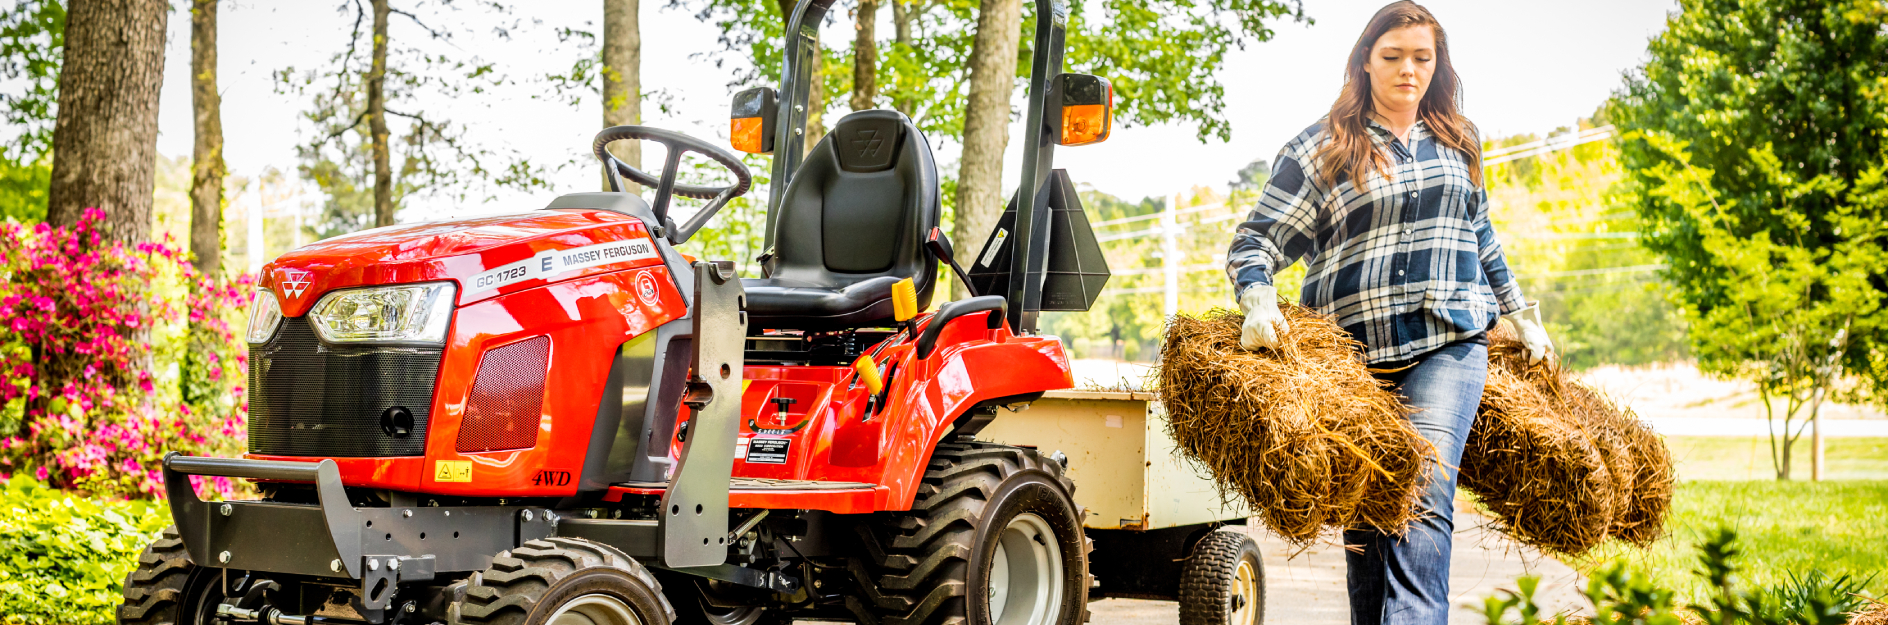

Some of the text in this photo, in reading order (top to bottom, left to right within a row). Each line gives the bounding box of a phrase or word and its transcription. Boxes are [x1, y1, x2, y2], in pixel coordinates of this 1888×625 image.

[476, 243, 650, 288] GC 1723 E MASSEY FERGUSON
[532, 470, 571, 486] 4WD
